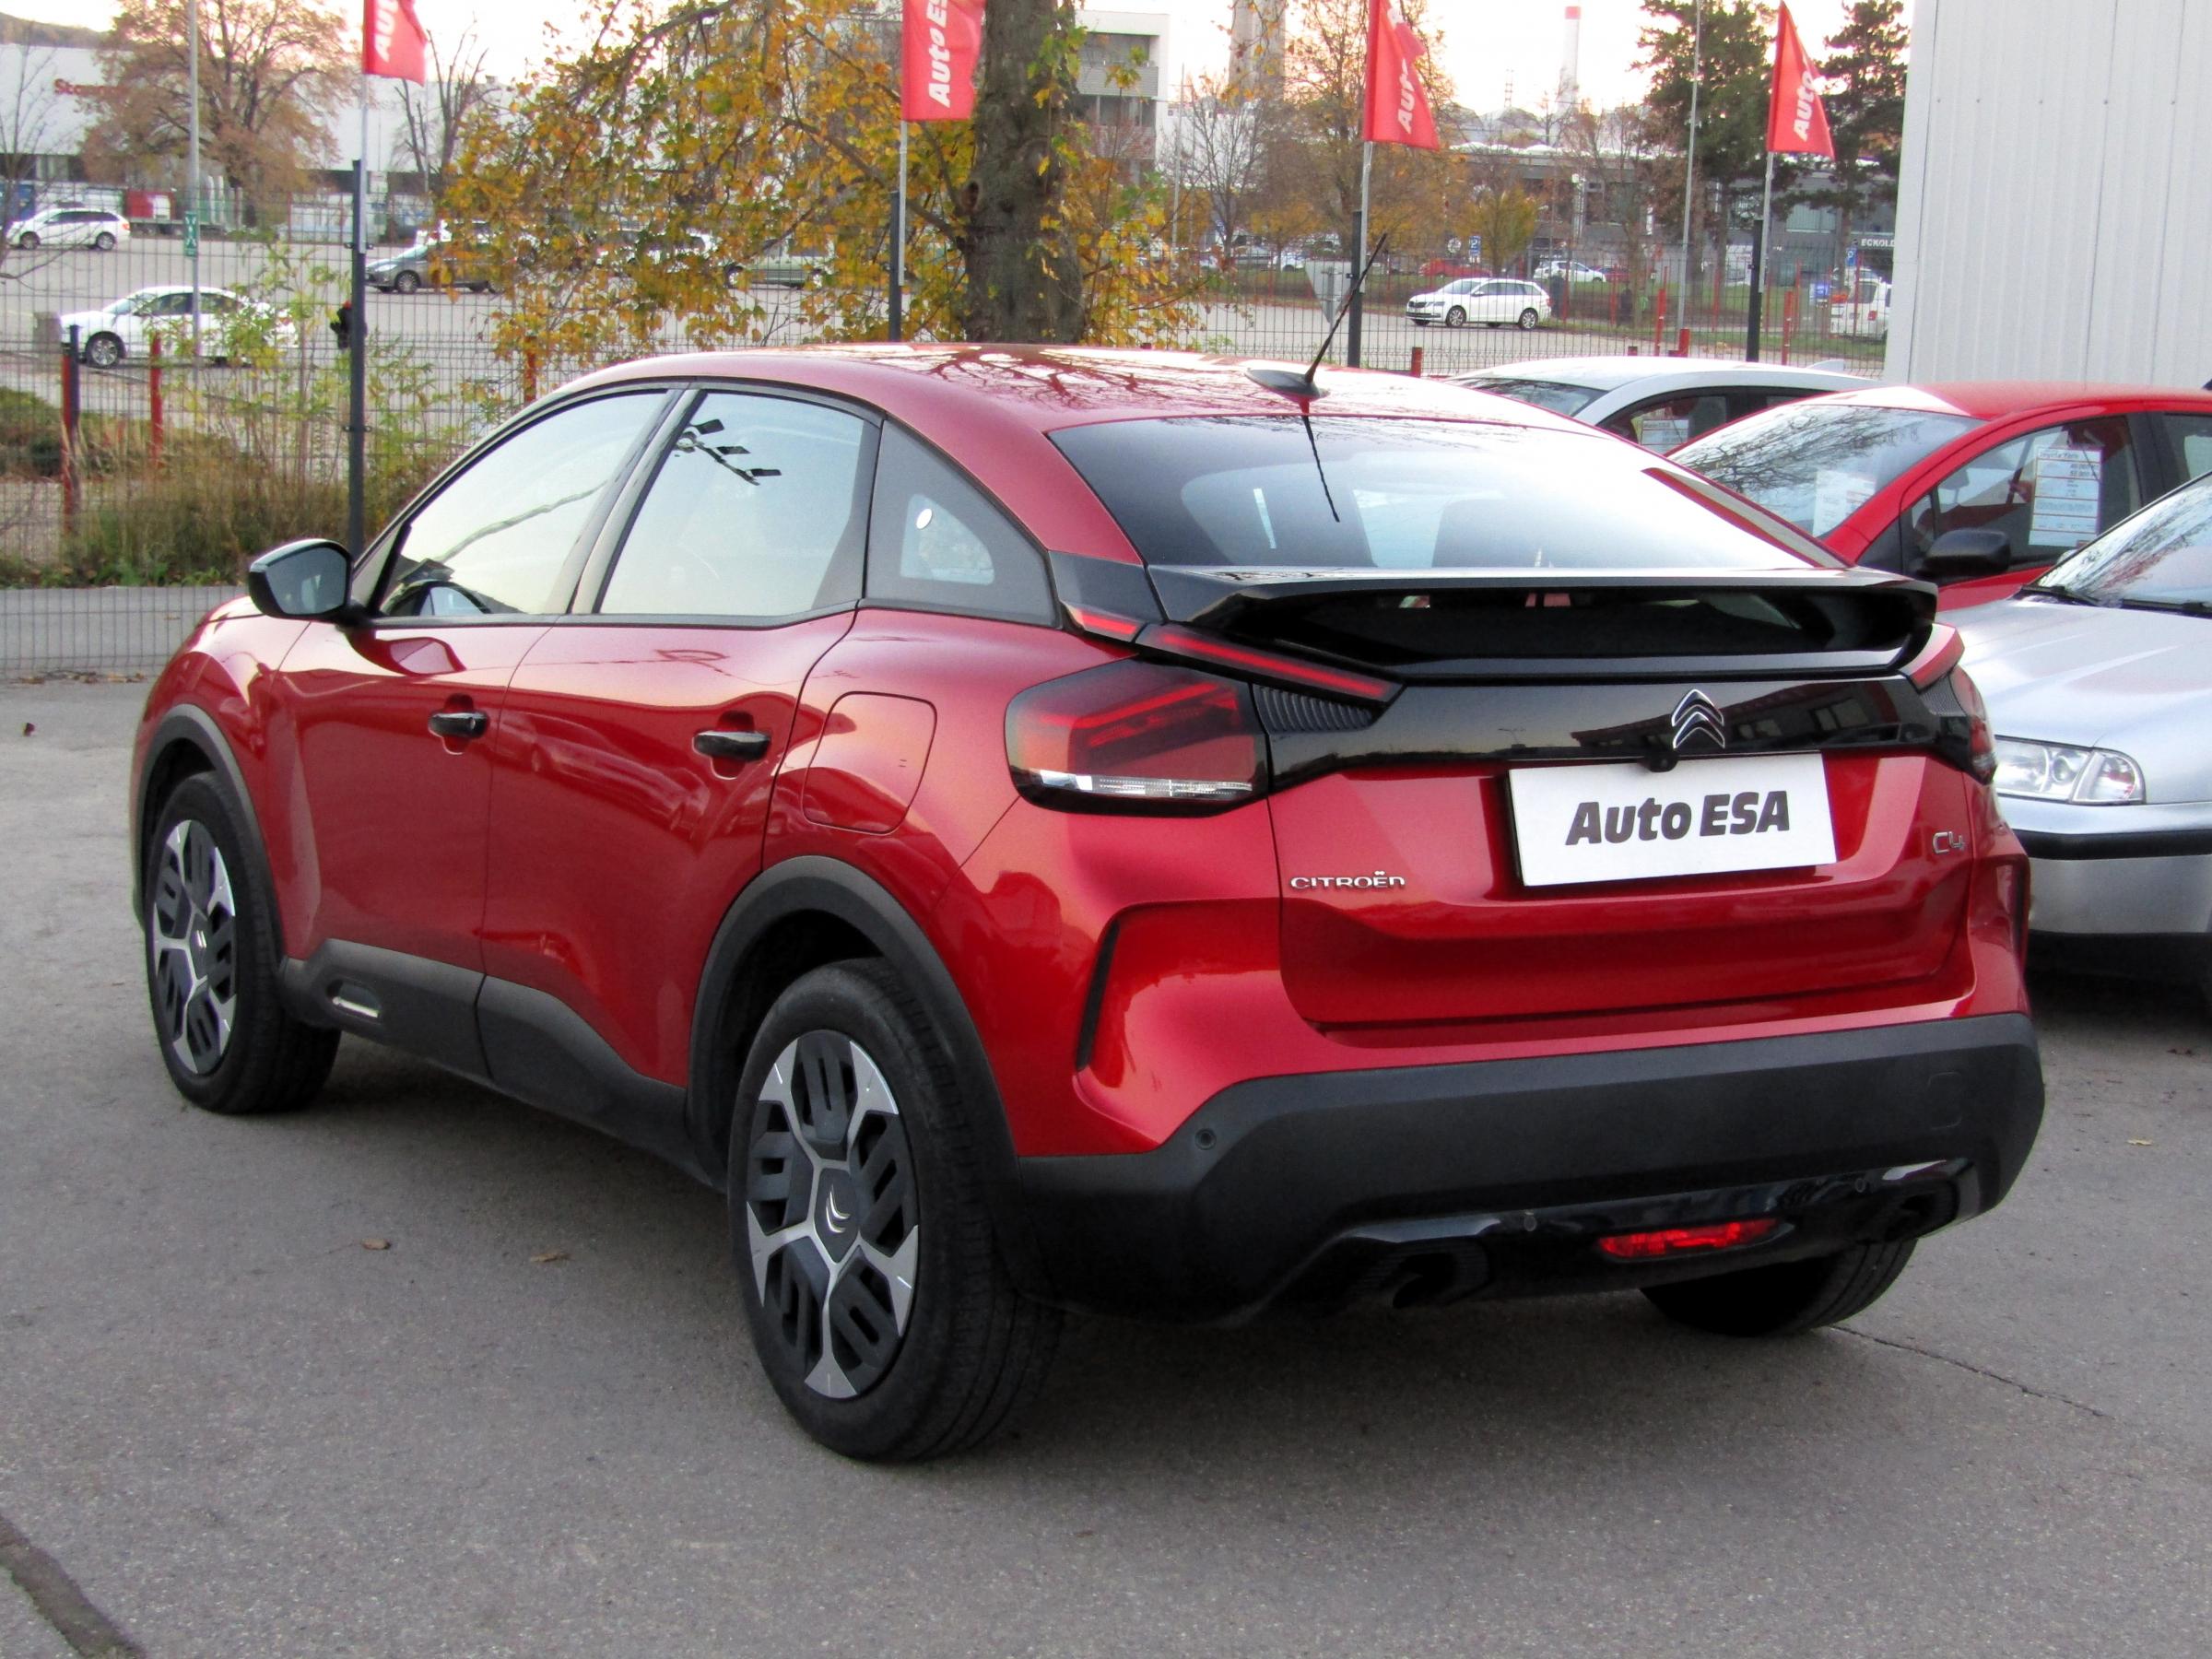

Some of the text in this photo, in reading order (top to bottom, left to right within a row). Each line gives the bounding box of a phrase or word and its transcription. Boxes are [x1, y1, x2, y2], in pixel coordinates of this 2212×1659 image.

[925, 0, 950, 108] Auto E
[1565, 790, 1790, 846] Auto ESA
[1932, 830, 1966, 854] C4
